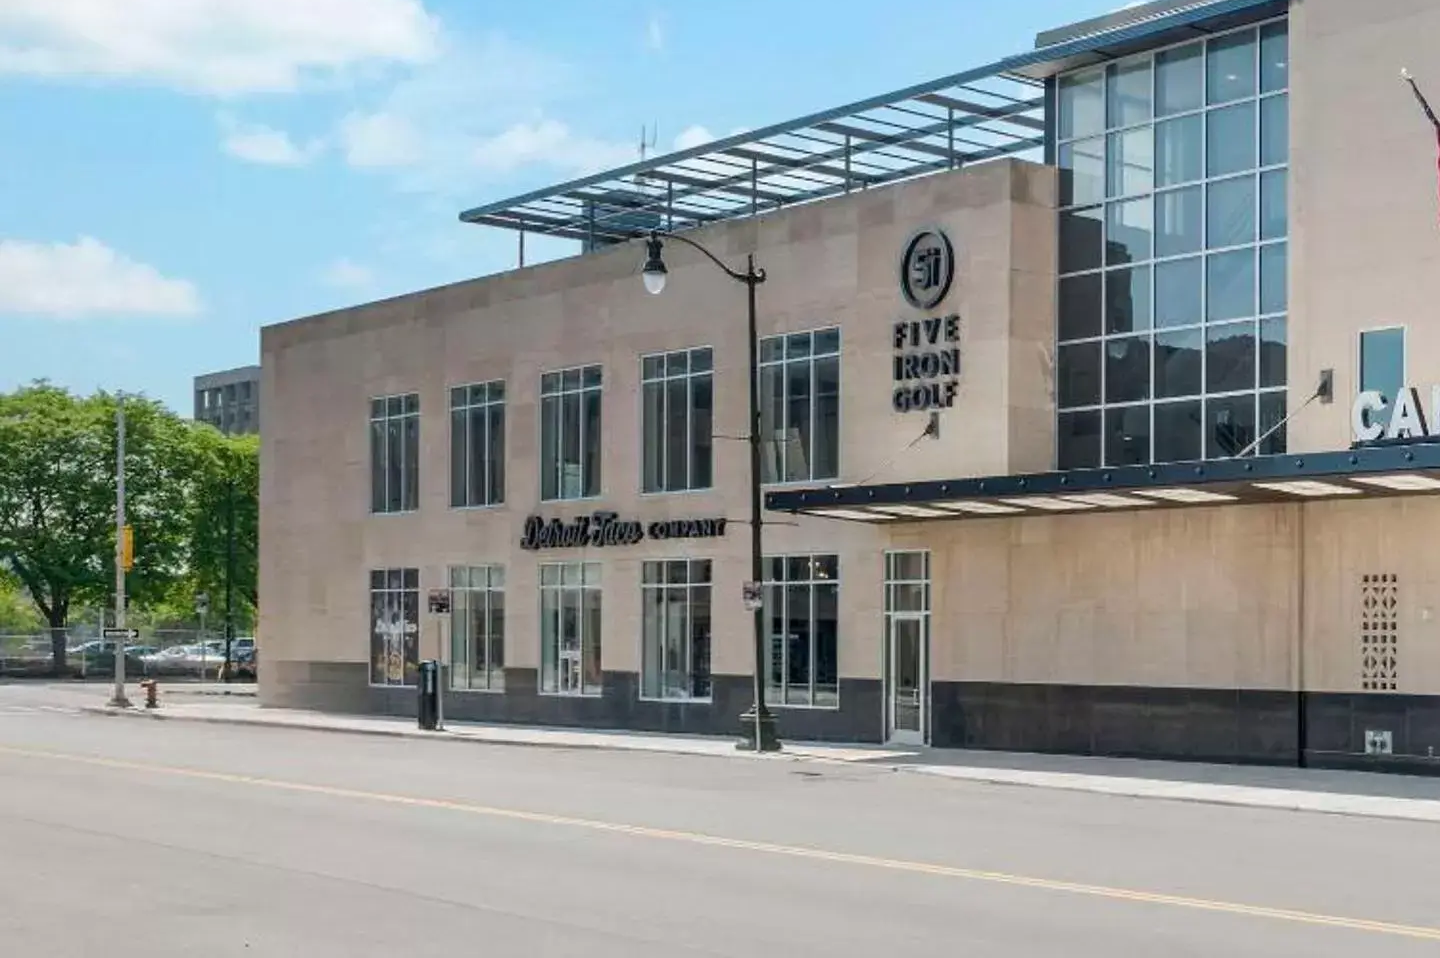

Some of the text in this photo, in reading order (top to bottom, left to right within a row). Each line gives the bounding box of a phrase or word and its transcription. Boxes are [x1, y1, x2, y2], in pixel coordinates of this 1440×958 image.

[893, 314, 961, 349] FIVE
[893, 348, 961, 381] IRON
[893, 380, 959, 413] GOLF
[520, 515, 590, 550] Detroit
[648, 518, 727, 539] COMPANY
